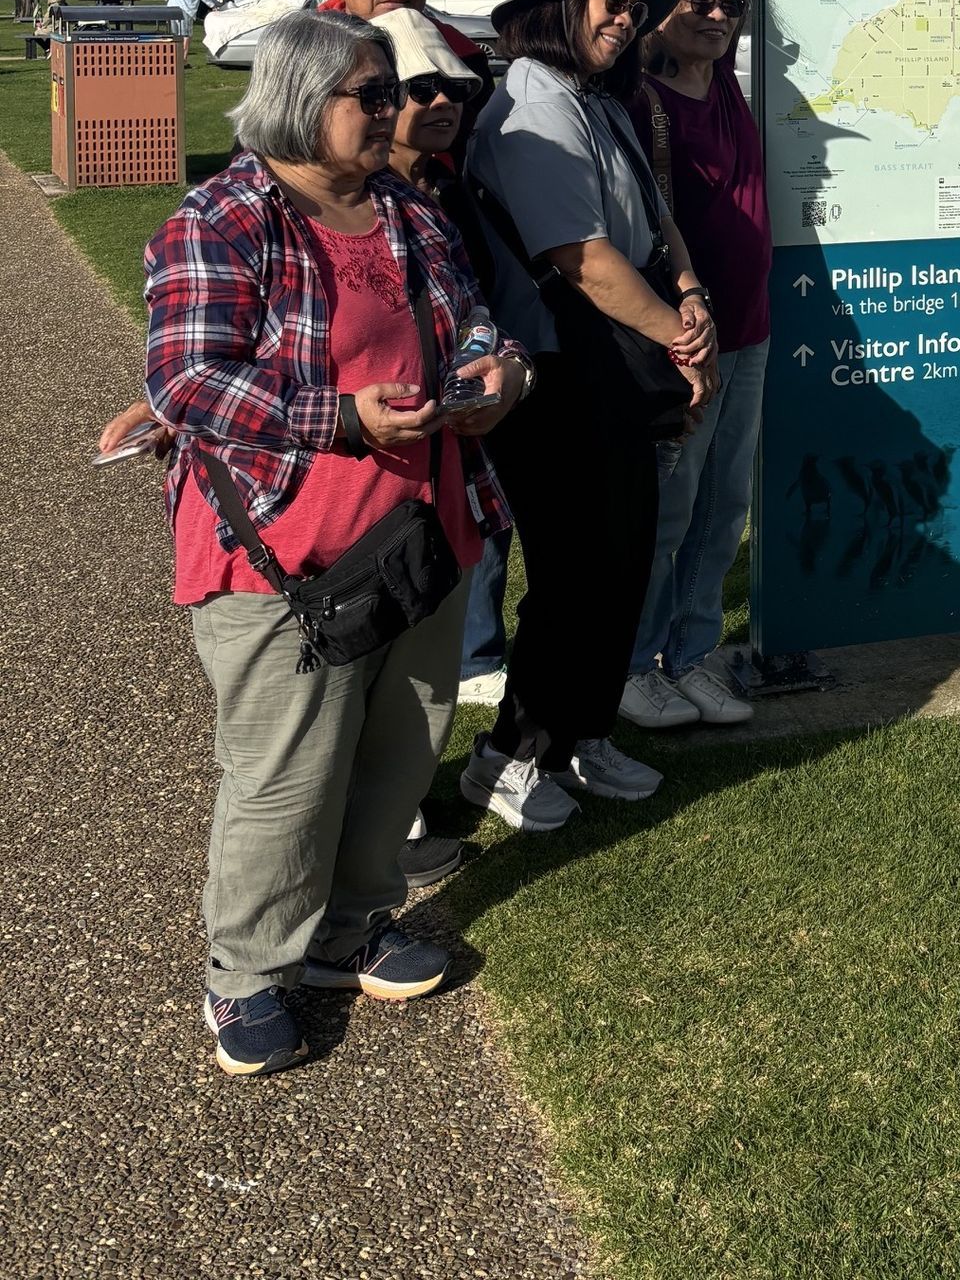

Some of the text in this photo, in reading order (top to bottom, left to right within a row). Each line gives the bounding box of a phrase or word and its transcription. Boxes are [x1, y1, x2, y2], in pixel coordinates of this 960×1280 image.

[831, 267, 903, 293] Phillip
[832, 300, 854, 316] via
[859, 297, 888, 314] the
[893, 294, 945, 315] bridge
[831, 338, 910, 361] Visitor
[831, 362, 958, 386] Centre 2km
